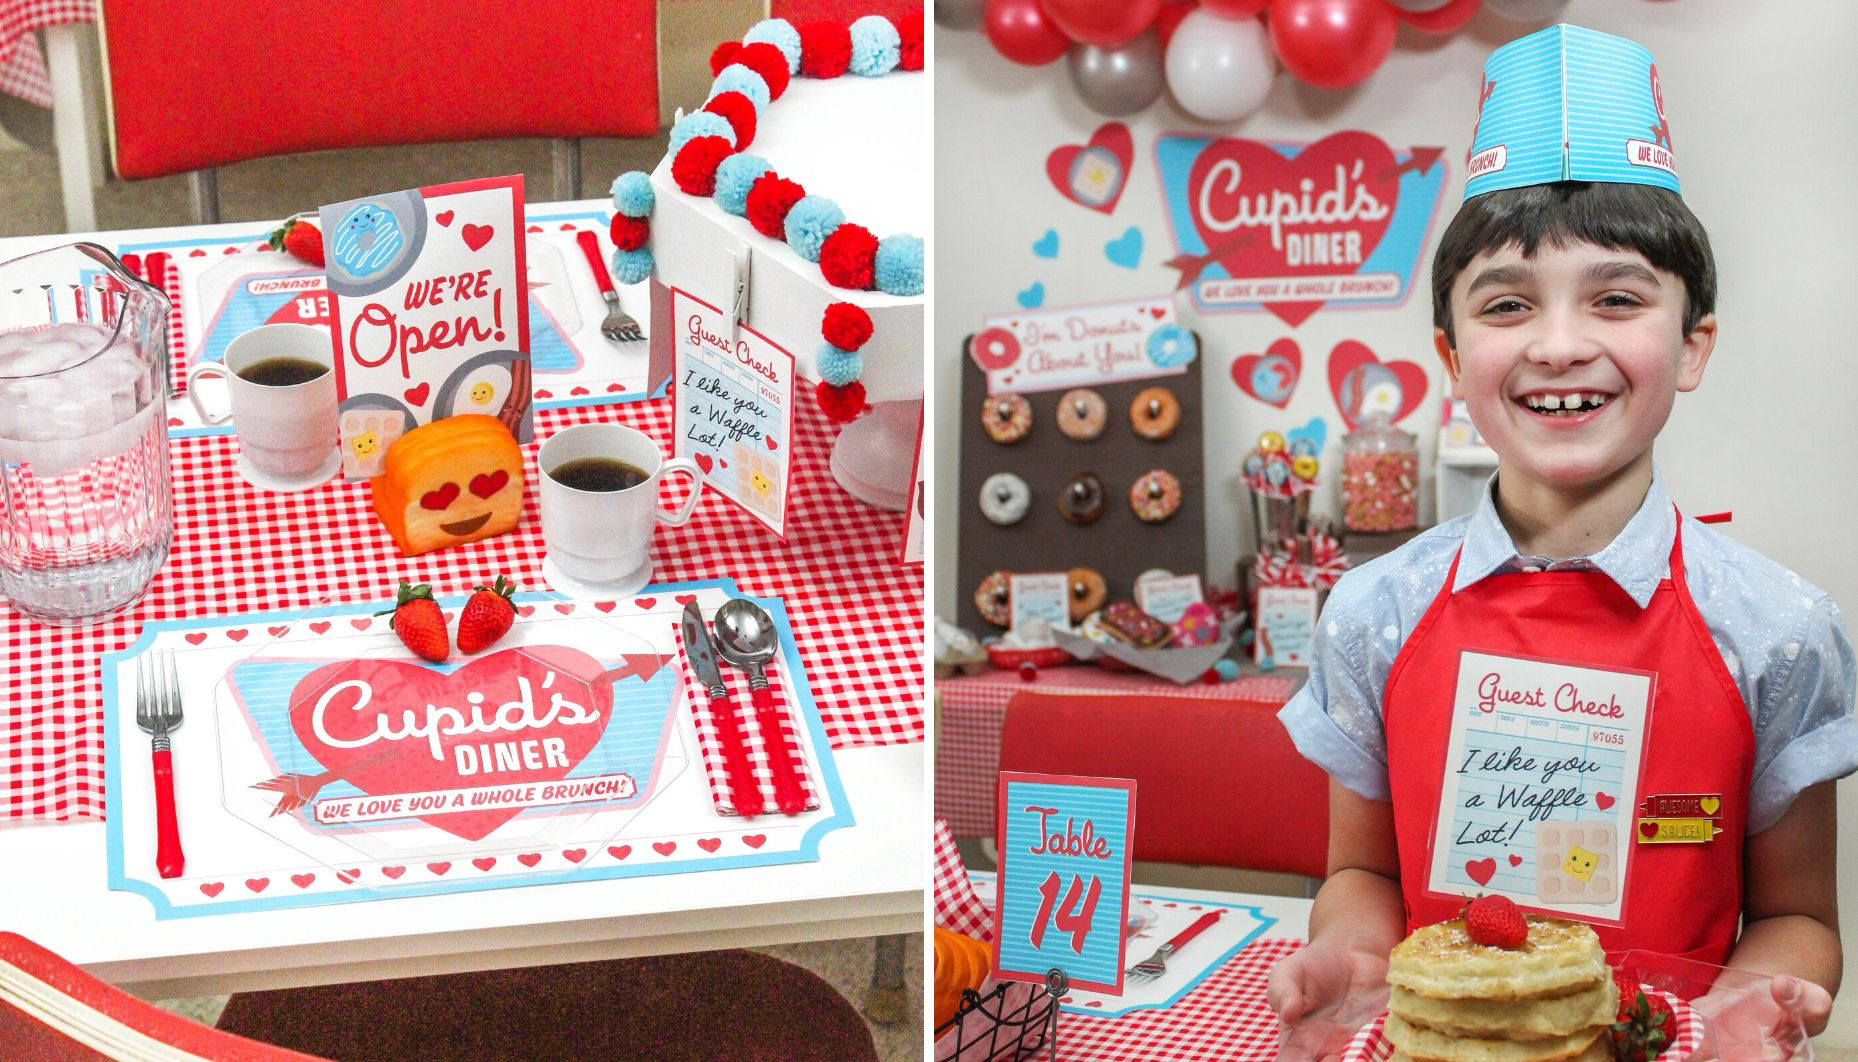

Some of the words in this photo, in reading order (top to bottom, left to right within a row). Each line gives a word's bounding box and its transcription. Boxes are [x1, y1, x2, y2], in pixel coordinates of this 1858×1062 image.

[1638, 145, 1651, 162] WE
[1653, 148, 1668, 167] LOVE
[1200, 158, 1389, 250] Cupid's
[1286, 231, 1362, 266] DINER
[253, 278, 321, 292] BRUNCH!
[404, 269, 493, 311] WE'RE
[349, 287, 506, 378] Open!
[688, 315, 732, 354] Guest
[736, 340, 779, 383] Check
[1026, 350, 1090, 375] About
[683, 369, 695, 386] I
[696, 377, 730, 400] like
[734, 397, 768, 418] you
[687, 423, 726, 451] Lot!
[690, 405, 701, 415] a
[709, 404, 762, 442] Waffle
[1478, 672, 1546, 713] Guest
[1554, 683, 1625, 719] Check
[312, 672, 600, 761] Cupid's
[454, 737, 570, 775] DINER
[1592, 731, 1625, 746] 97055
[1456, 749, 1481, 774] I
[1478, 746, 1537, 772] like
[1541, 757, 1601, 784] you
[322, 801, 351, 819] WE
[357, 798, 403, 816] LOVE
[408, 795, 446, 813] YOU
[451, 793, 465, 808] A
[471, 788, 537, 807] WHOLE
[541, 779, 628, 799] BRUNCH!
[1465, 794, 1485, 808] a
[1497, 784, 1589, 821] Waffle
[1660, 799, 1700, 814] AWESOME
[1025, 805, 1112, 859] Table
[1456, 819, 1524, 847] Lot!
[1661, 823, 1700, 839] SAUCE!
[1029, 870, 1103, 956] 14
